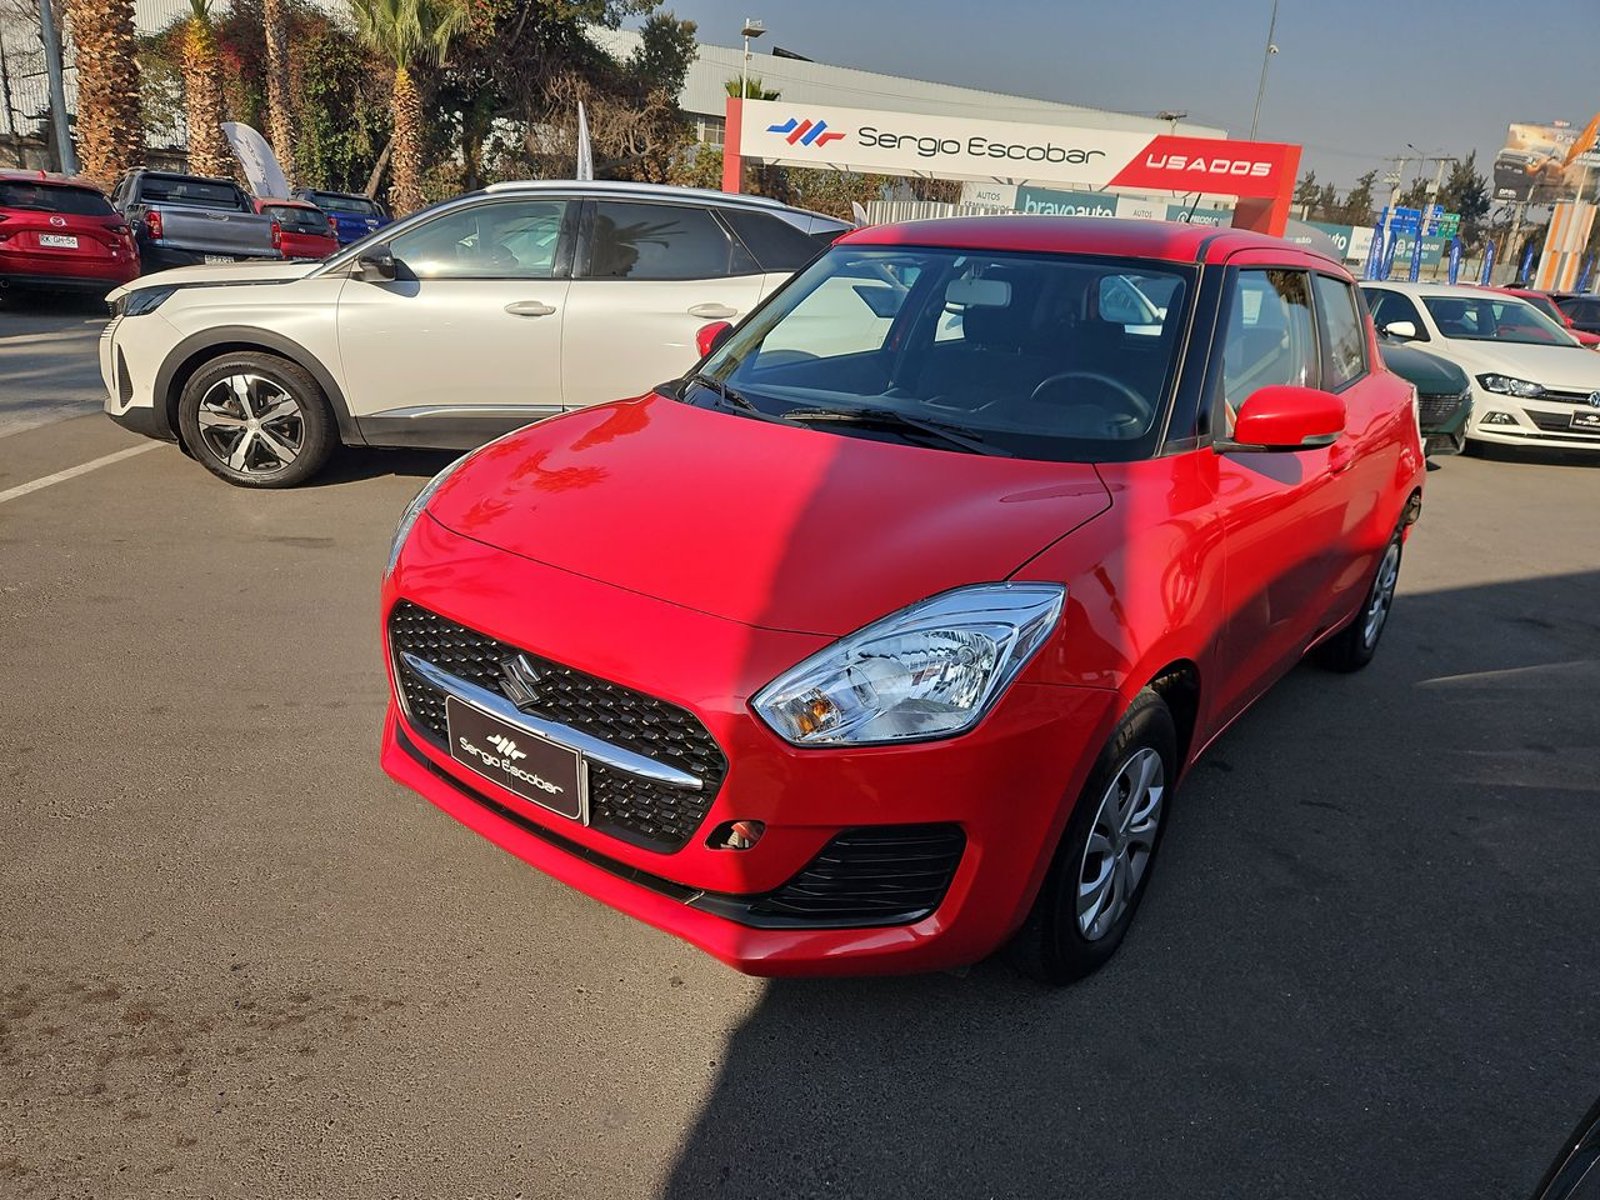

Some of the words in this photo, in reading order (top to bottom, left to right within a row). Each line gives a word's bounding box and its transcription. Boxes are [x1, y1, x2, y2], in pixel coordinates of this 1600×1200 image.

[858, 126, 962, 158] Sergio
[967, 137, 1107, 165] Escobar
[1145, 153, 1272, 177] USADOS
[976, 191, 1001, 201] AUTOS
[501, 758, 564, 795] Escobar
